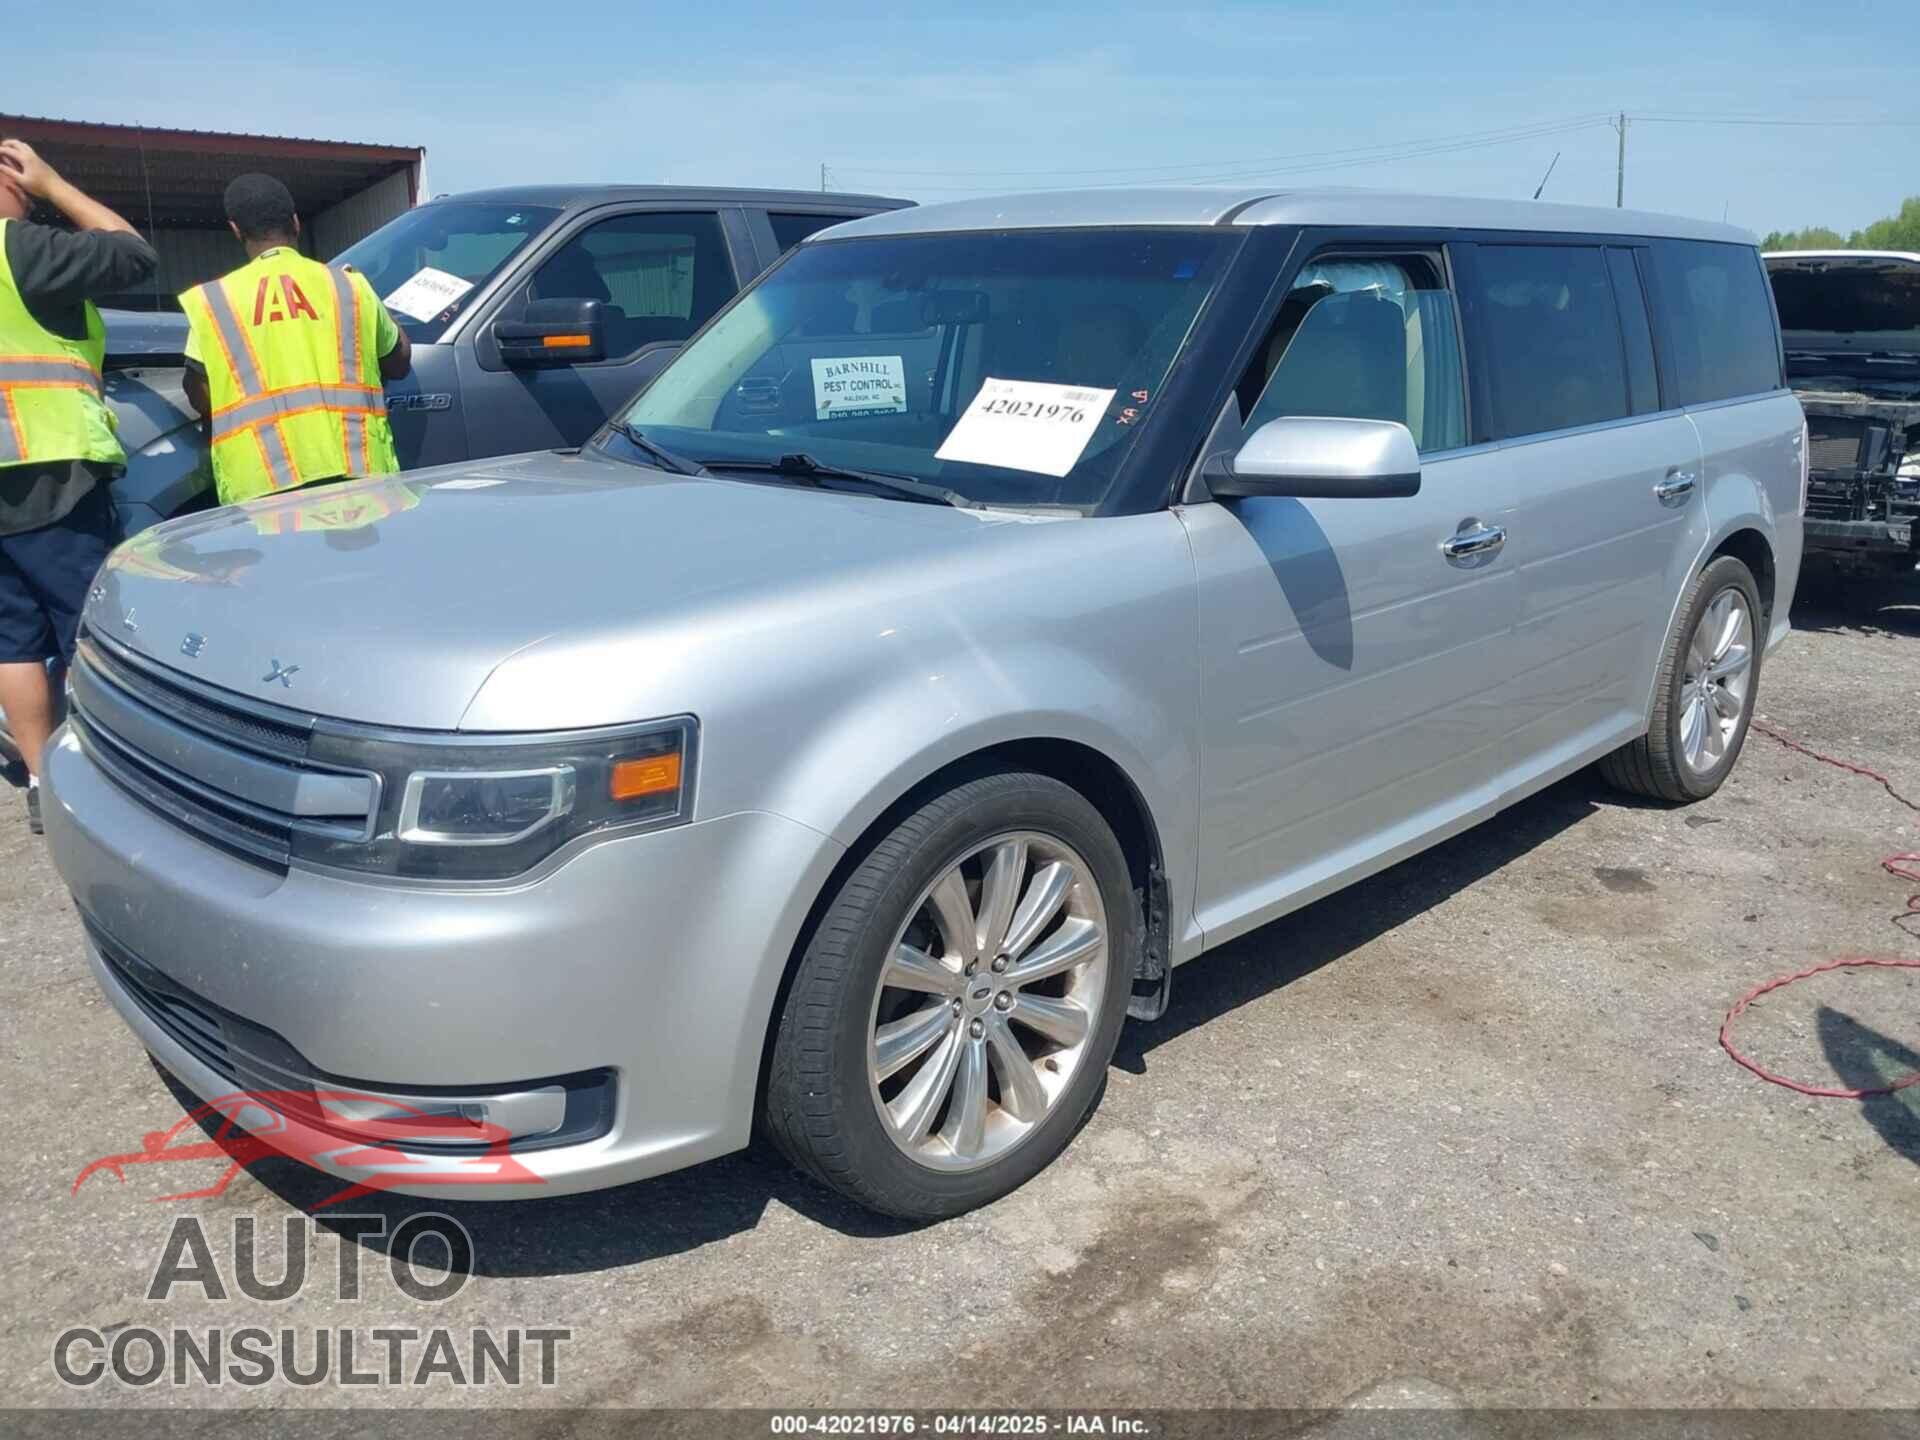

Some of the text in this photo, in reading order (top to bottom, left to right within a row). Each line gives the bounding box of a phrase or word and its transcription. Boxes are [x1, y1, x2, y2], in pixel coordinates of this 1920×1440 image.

[826, 362, 889, 377] BARNHILL
[824, 381, 847, 392] PEST
[850, 379, 893, 391] CONTROL
[982, 399, 1085, 423] 42021976
